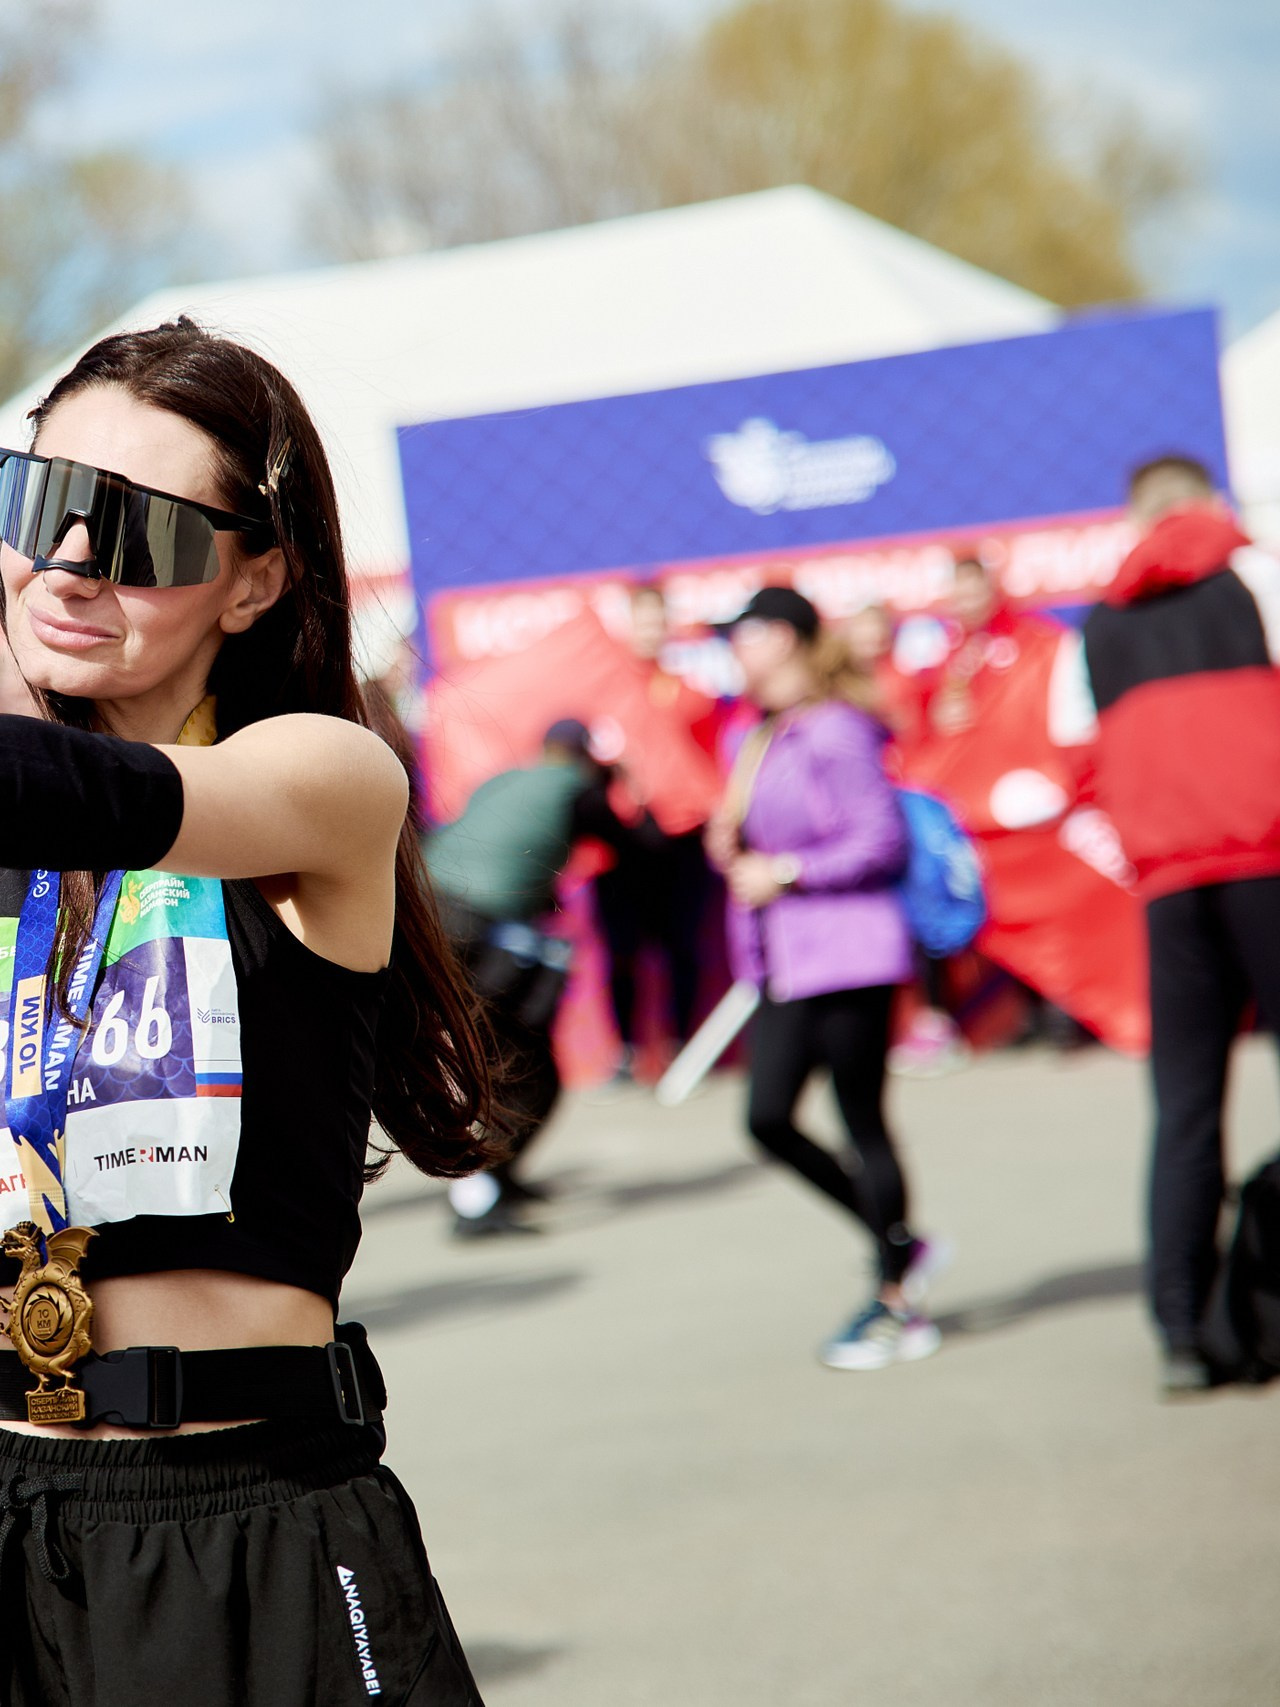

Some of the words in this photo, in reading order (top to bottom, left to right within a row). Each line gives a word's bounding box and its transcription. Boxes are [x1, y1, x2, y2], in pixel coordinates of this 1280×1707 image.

[140, 888, 190, 910] КАЗАНСКИЙ
[211, 1016, 236, 1024] BRICS
[19, 1042, 37, 1075] 10
[37, 1309, 50, 1319] 10
